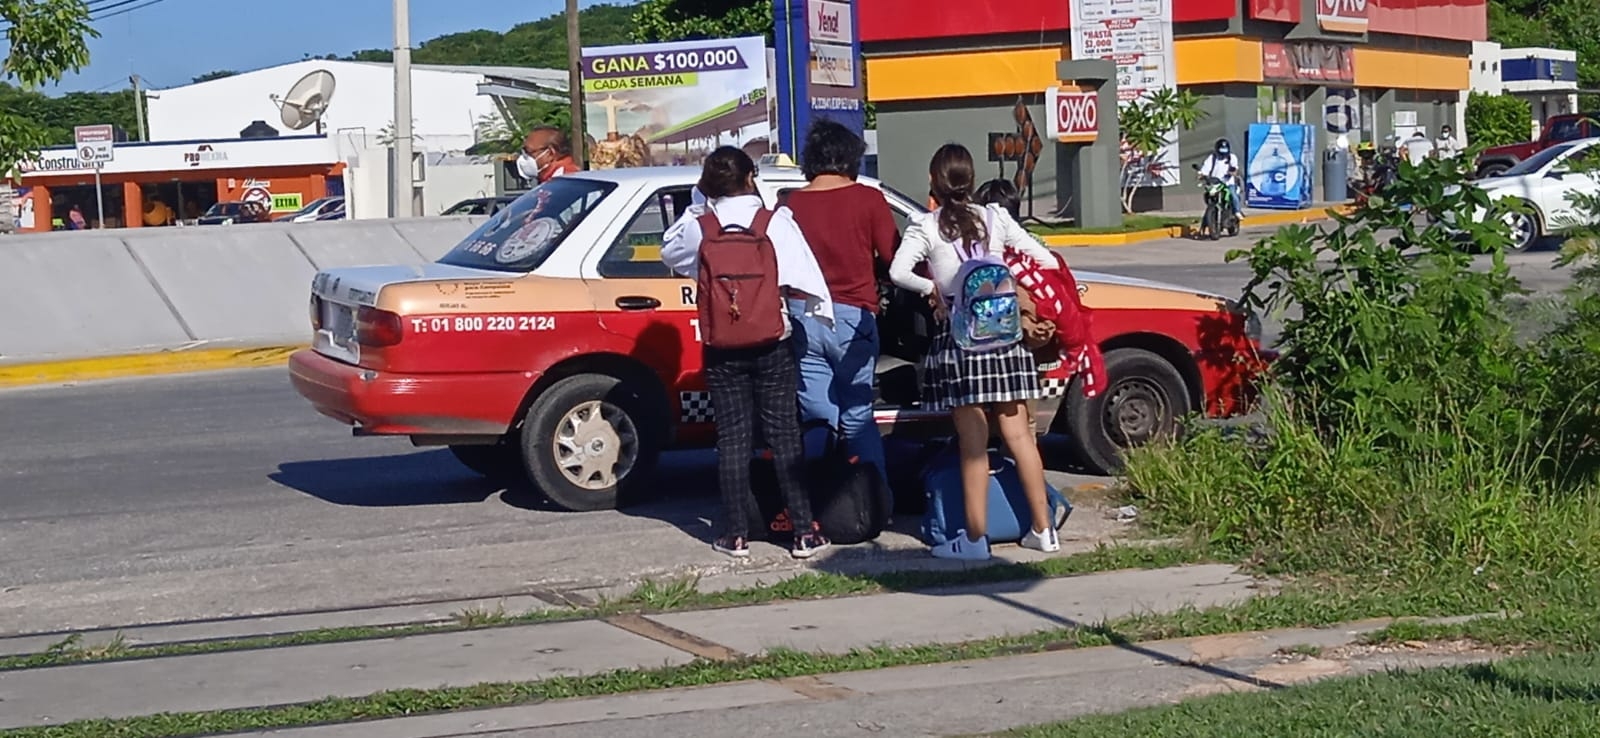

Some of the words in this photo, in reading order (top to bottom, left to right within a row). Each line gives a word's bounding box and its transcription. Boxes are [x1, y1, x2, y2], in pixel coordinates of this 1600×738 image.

[592, 56, 649, 74] GANA
[654, 49, 737, 71] $100,000
[593, 78, 627, 90] CADA
[630, 75, 683, 88] SEMANA
[1058, 97, 1097, 132] OXXO
[275, 198, 298, 208] EXTRA
[411, 318, 428, 333] T:
[431, 318, 449, 332] 01
[454, 317, 483, 331] 800
[486, 317, 515, 331] 220
[519, 316, 556, 330] 2124
